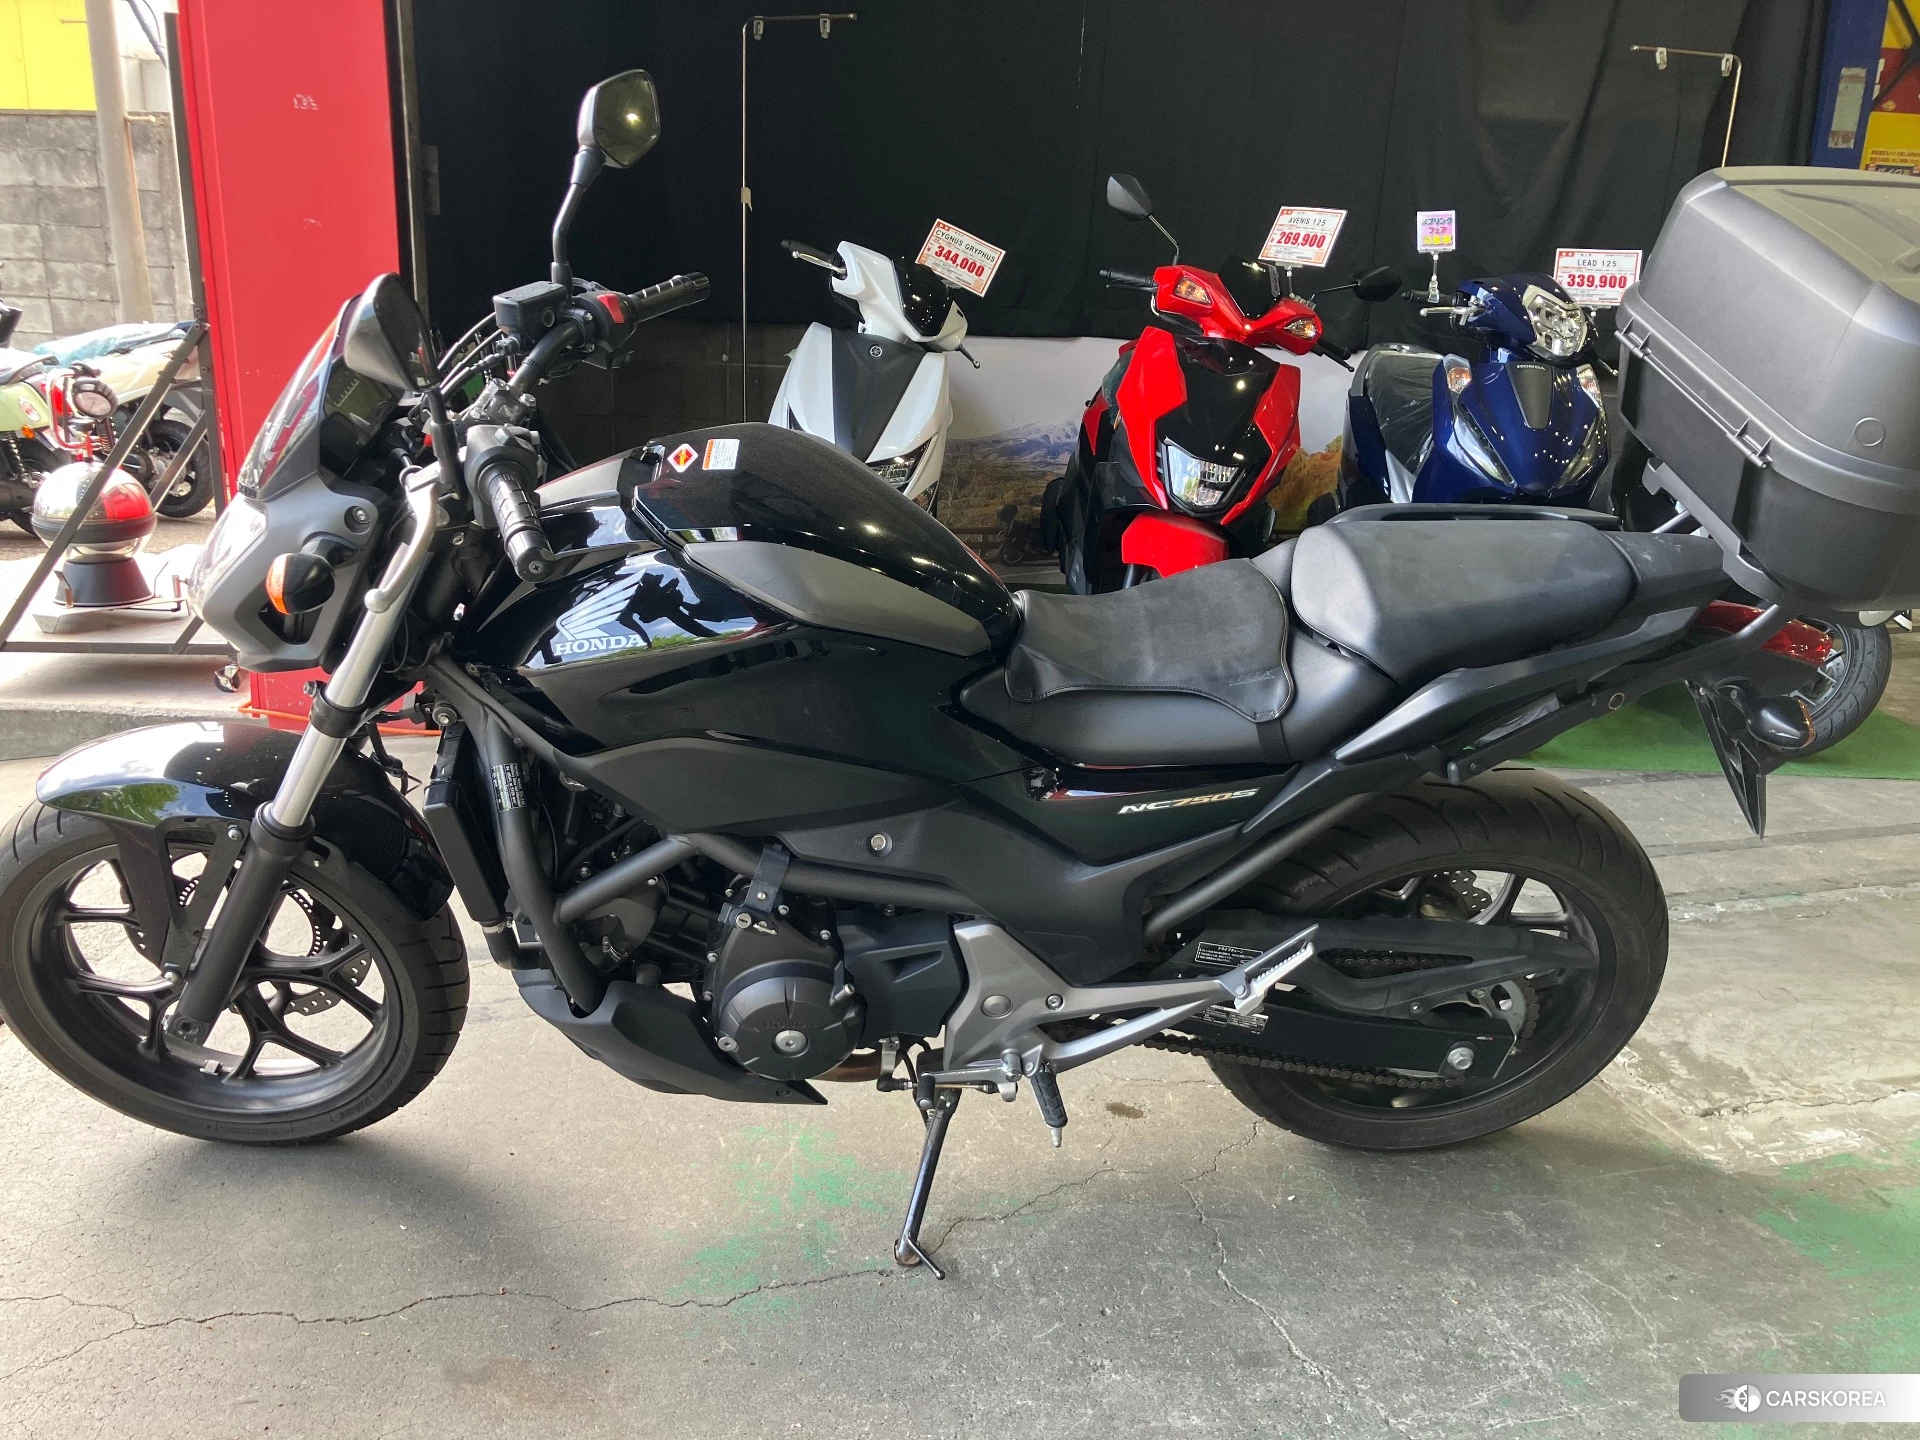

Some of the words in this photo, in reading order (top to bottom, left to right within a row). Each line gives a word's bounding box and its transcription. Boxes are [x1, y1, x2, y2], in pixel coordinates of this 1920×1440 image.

[1288, 217, 1310, 225] AVENIS
[1312, 218, 1327, 227] 125
[1428, 226, 1447, 235] フェア
[935, 229, 964, 247] CYGNUS
[964, 243, 996, 263] GRYPHUS
[1276, 231, 1326, 249] 269,900
[934, 245, 985, 277] 344,000
[1577, 259, 1598, 267] LEAD
[1567, 273, 1628, 289] 339,900
[553, 634, 648, 657] HONDA
[1117, 787, 1261, 815] NC750S
